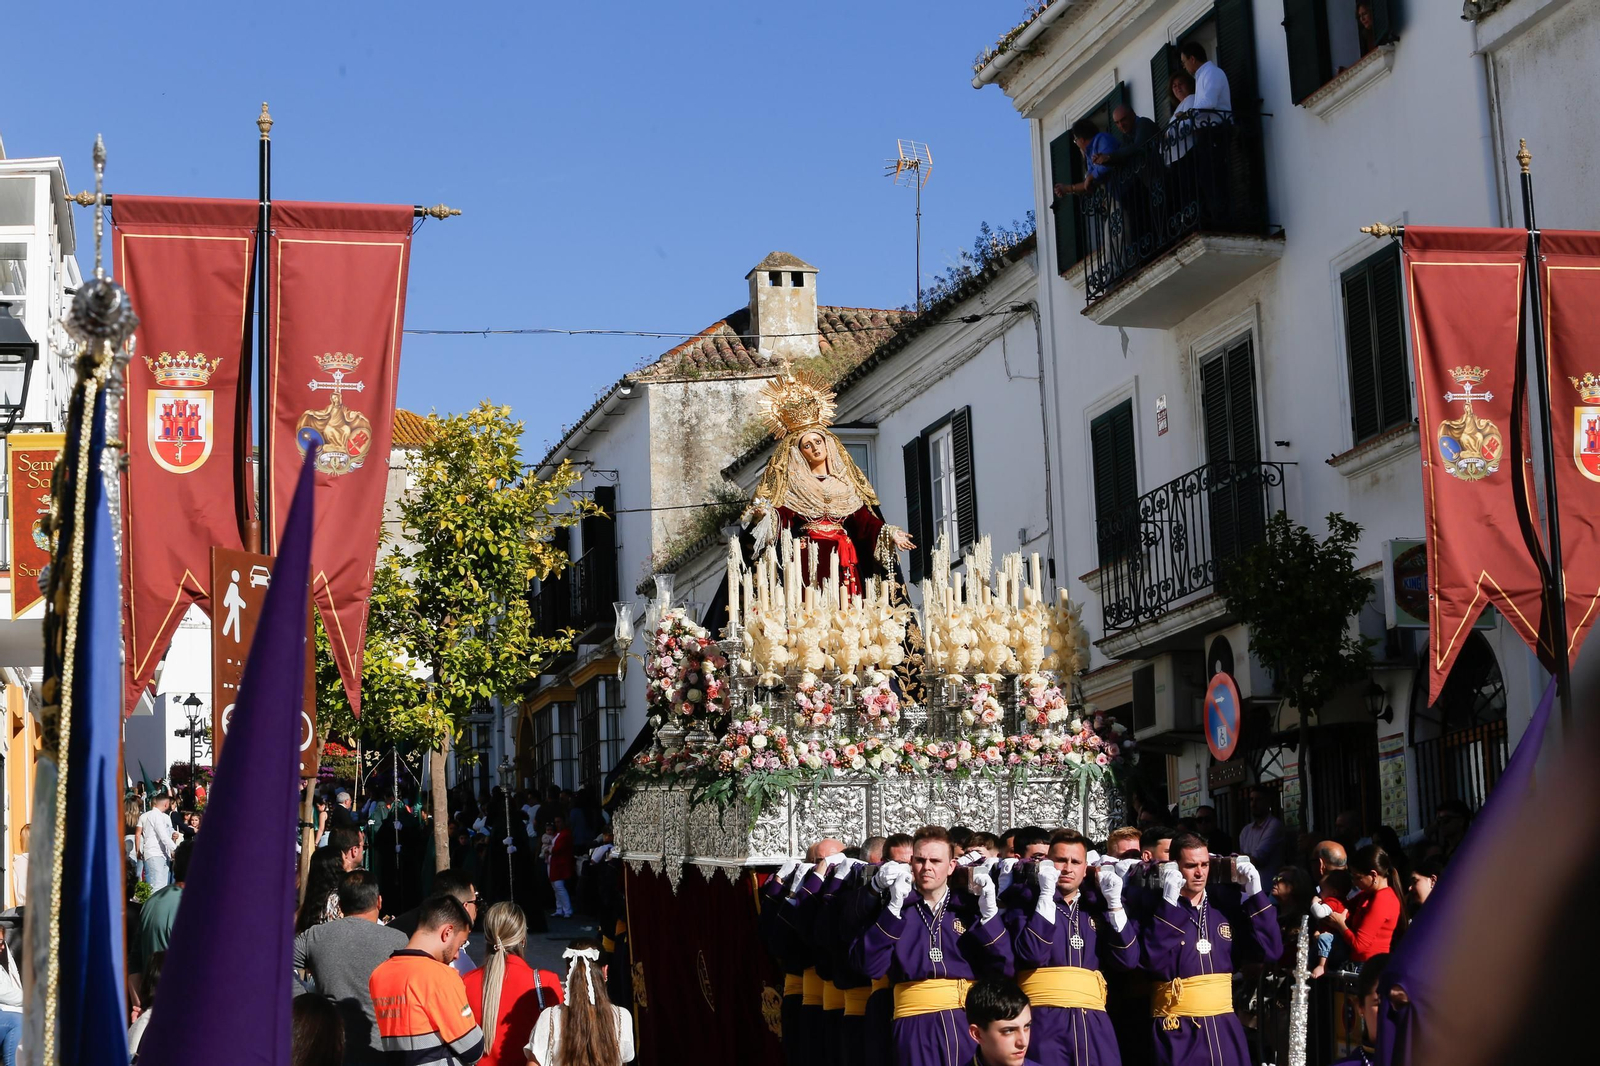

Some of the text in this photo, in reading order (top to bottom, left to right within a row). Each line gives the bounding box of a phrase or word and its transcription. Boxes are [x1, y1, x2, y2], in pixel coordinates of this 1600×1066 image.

[18, 454, 54, 471] Sem
[27, 471, 51, 489] Sa
[1403, 577, 1422, 590] KING
